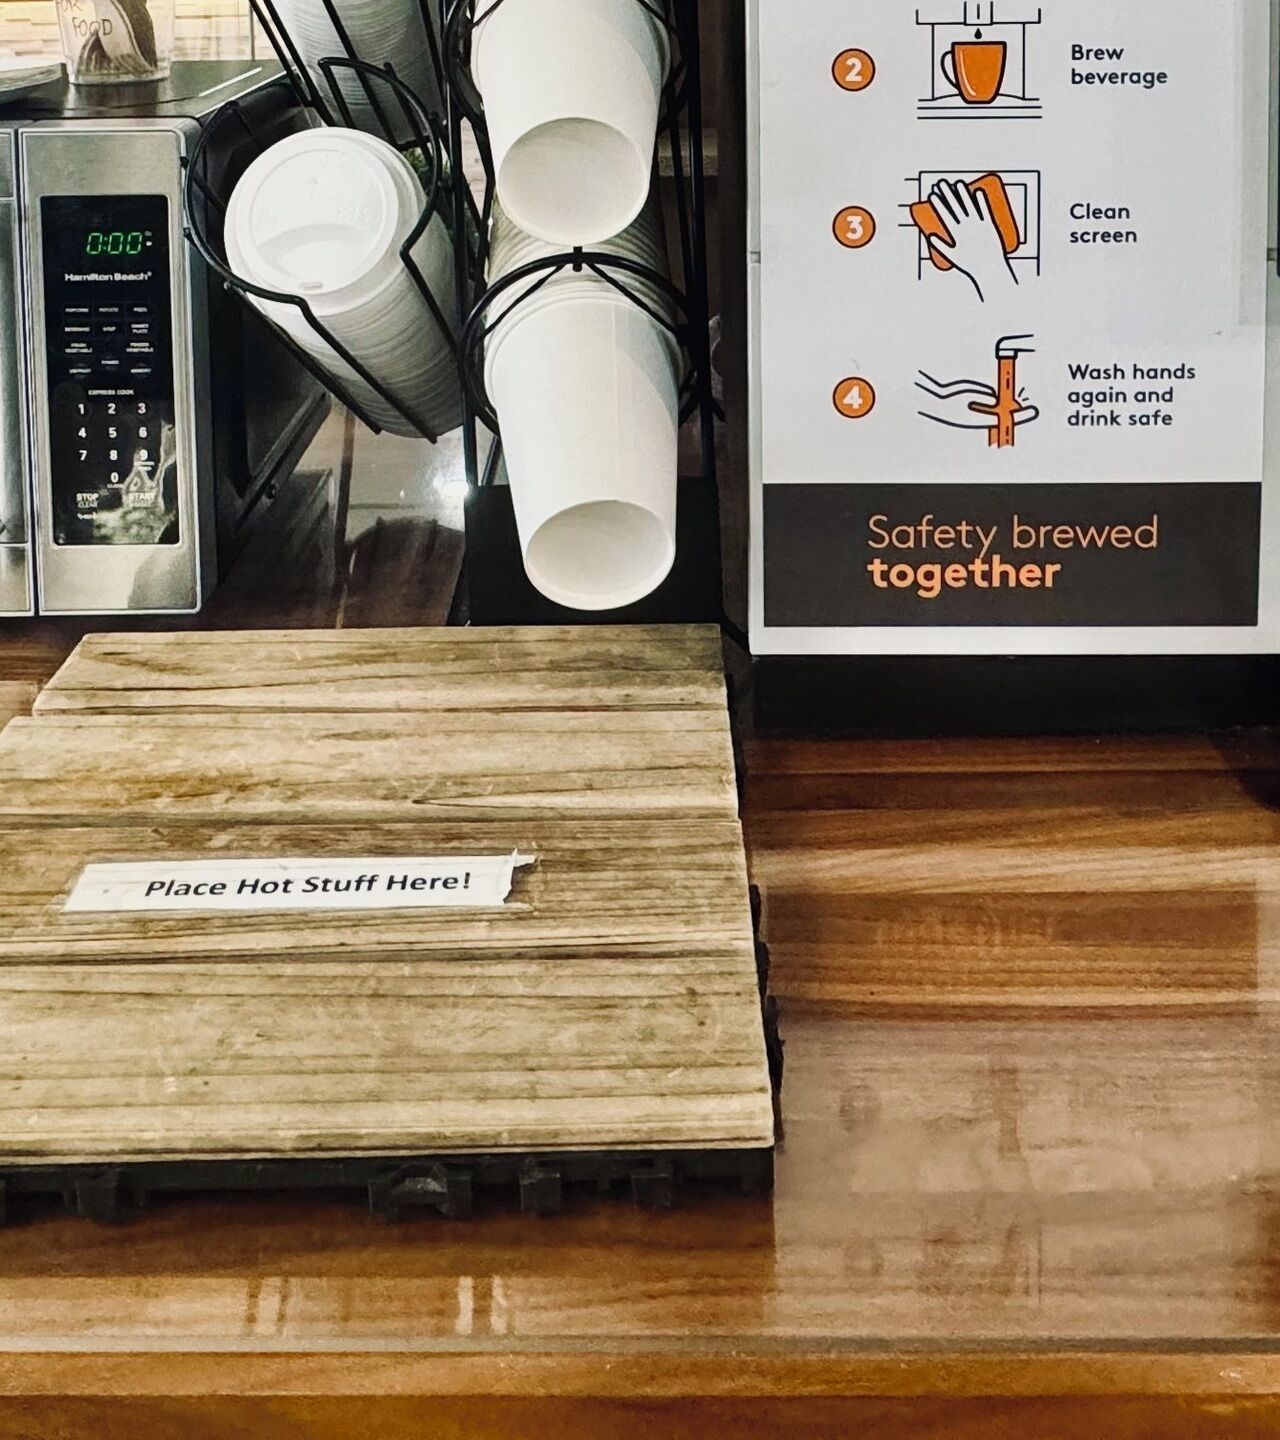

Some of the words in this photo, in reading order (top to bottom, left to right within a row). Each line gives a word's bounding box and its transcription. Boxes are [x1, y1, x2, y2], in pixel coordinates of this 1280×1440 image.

[72, 17, 112, 37] FOOD
[1072, 44, 1124, 60] Brew
[1072, 68, 1167, 89] beverage
[1070, 203, 1129, 219] Clean
[1070, 231, 1137, 243] screen
[86, 232, 142, 254] 0:00
[65, 273, 113, 281] Hamilton
[114, 272, 148, 281] Beach
[1068, 364, 1125, 380] Wash
[1133, 363, 1195, 379] hands
[1068, 386, 1126, 408] again
[1134, 387, 1173, 402] and
[78, 404, 84, 414] 1
[108, 404, 116, 414] 2
[138, 403, 146, 414] 3
[1068, 410, 1121, 426] drink
[1129, 409, 1172, 425] safe
[78, 427, 86, 438] 4
[109, 427, 117, 438] 5
[139, 427, 147, 438] 6
[79, 450, 87, 461] 7
[110, 450, 118, 461] 8
[140, 449, 148, 460] 9
[111, 472, 118, 483] 0
[76, 493, 99, 501] STOP
[867, 515, 998, 557] Safety
[1013, 515, 1159, 548] brewed
[867, 556, 1060, 598] together
[145, 880, 226, 896] Place
[237, 879, 293, 894] Hot
[302, 875, 379, 892] Stuff
[387, 872, 470, 890] Here!
